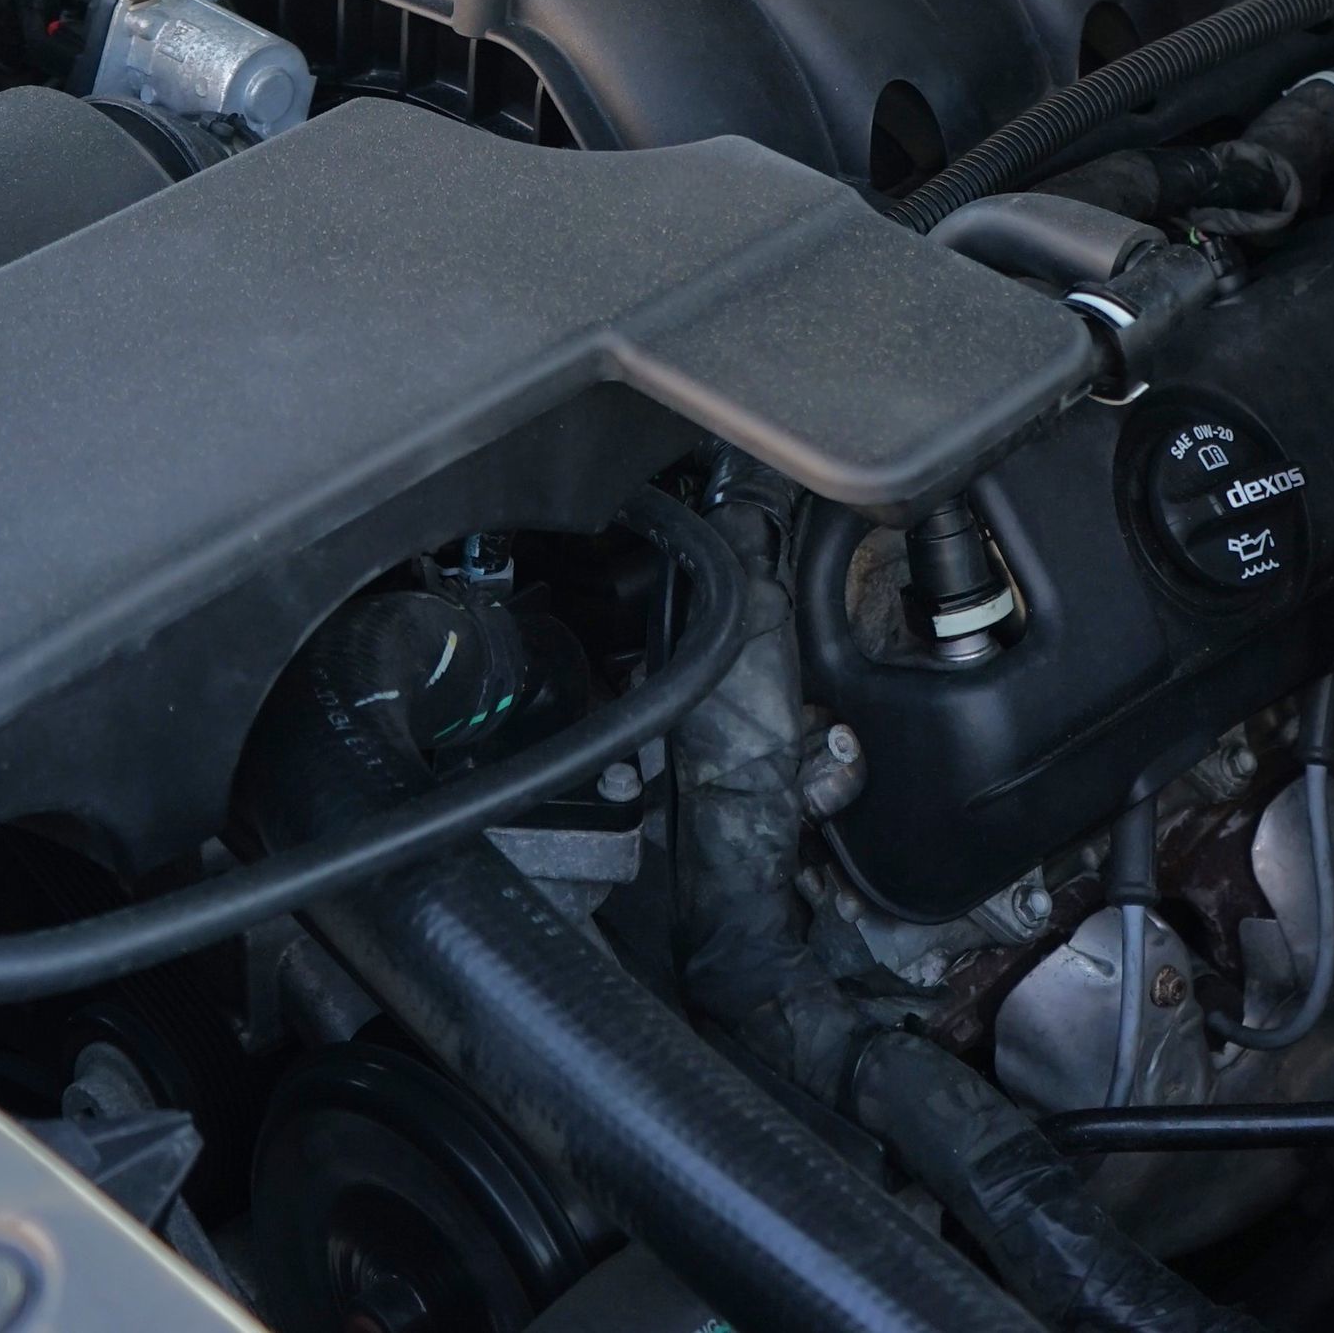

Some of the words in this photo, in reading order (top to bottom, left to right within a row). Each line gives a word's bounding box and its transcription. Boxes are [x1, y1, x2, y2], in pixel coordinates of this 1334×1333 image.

[1170, 433, 1194, 460] SAE
[1193, 424, 1234, 442] 0W-20
[1226, 467, 1306, 509] dexos
